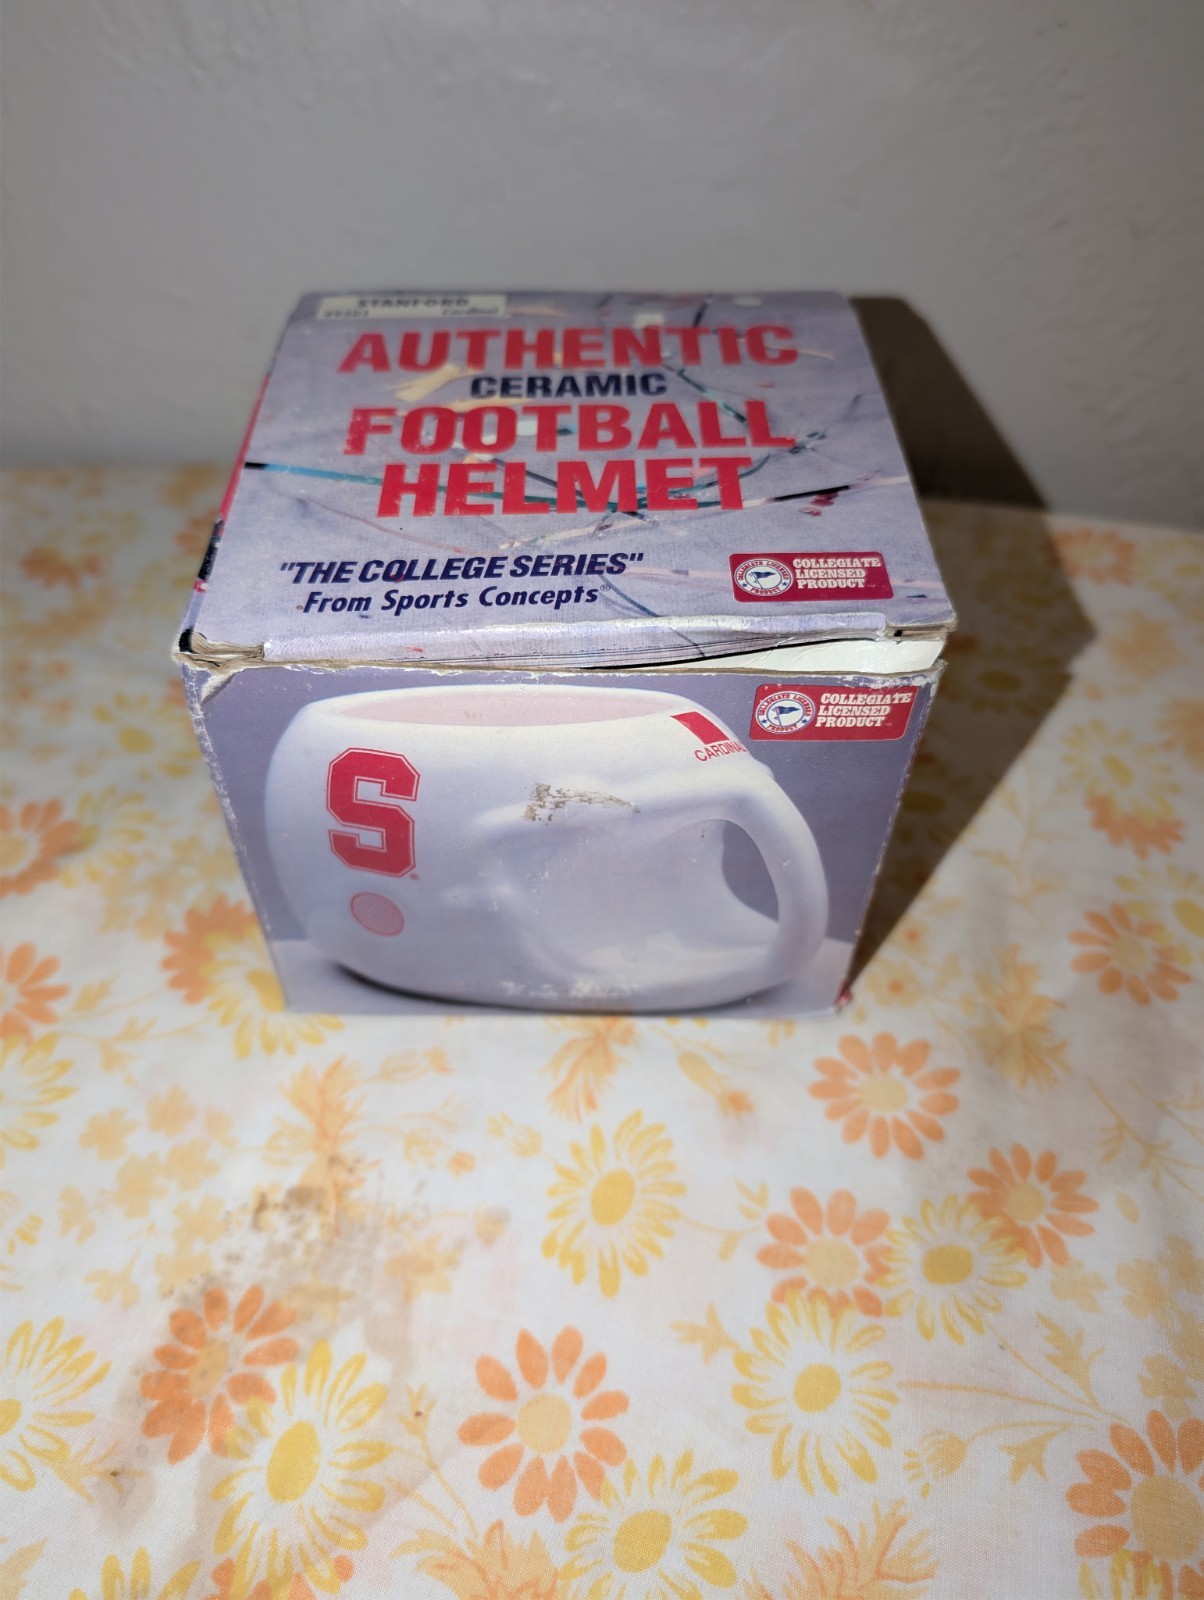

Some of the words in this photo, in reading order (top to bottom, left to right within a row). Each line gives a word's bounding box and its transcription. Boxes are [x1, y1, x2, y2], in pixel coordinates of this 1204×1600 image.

[356, 297, 470, 308] STANFORD
[337, 325, 798, 373] AUTHENTIC
[470, 374, 667, 398] CERAMIC
[343, 401, 796, 455] FOOTBALL
[377, 457, 752, 518] HELMET
[280, 561, 357, 584] "THE
[358, 556, 507, 583] COLLEGE
[509, 552, 644, 577] SERIES"
[792, 557, 882, 569] COLLEGIATE
[795, 569, 866, 579] LICENSED
[797, 578, 866, 589] PRODUCT
[303, 591, 372, 613] From
[381, 588, 468, 616] Sports
[820, 692, 913, 705] COLLEGIATE
[817, 705, 891, 717] LICENSED
[814, 716, 886, 728] PRODUCT
[327, 747, 421, 878] S
